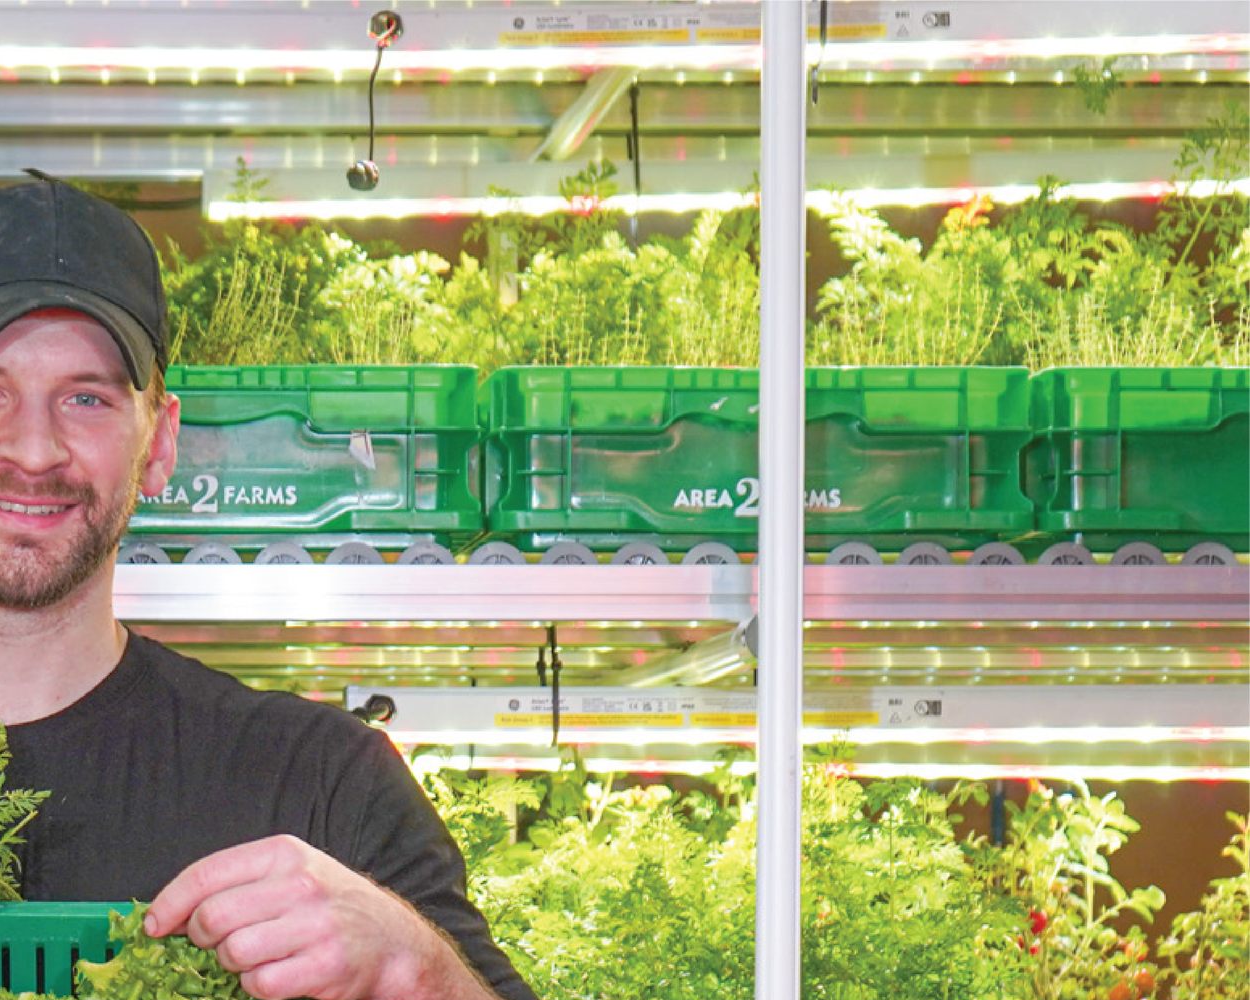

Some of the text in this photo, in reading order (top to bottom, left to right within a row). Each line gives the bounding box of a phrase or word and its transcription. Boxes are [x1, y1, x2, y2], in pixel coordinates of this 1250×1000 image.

[191, 474, 219, 513] 2
[223, 485, 298, 505] FARMS
[673, 477, 760, 517] AREA 2
